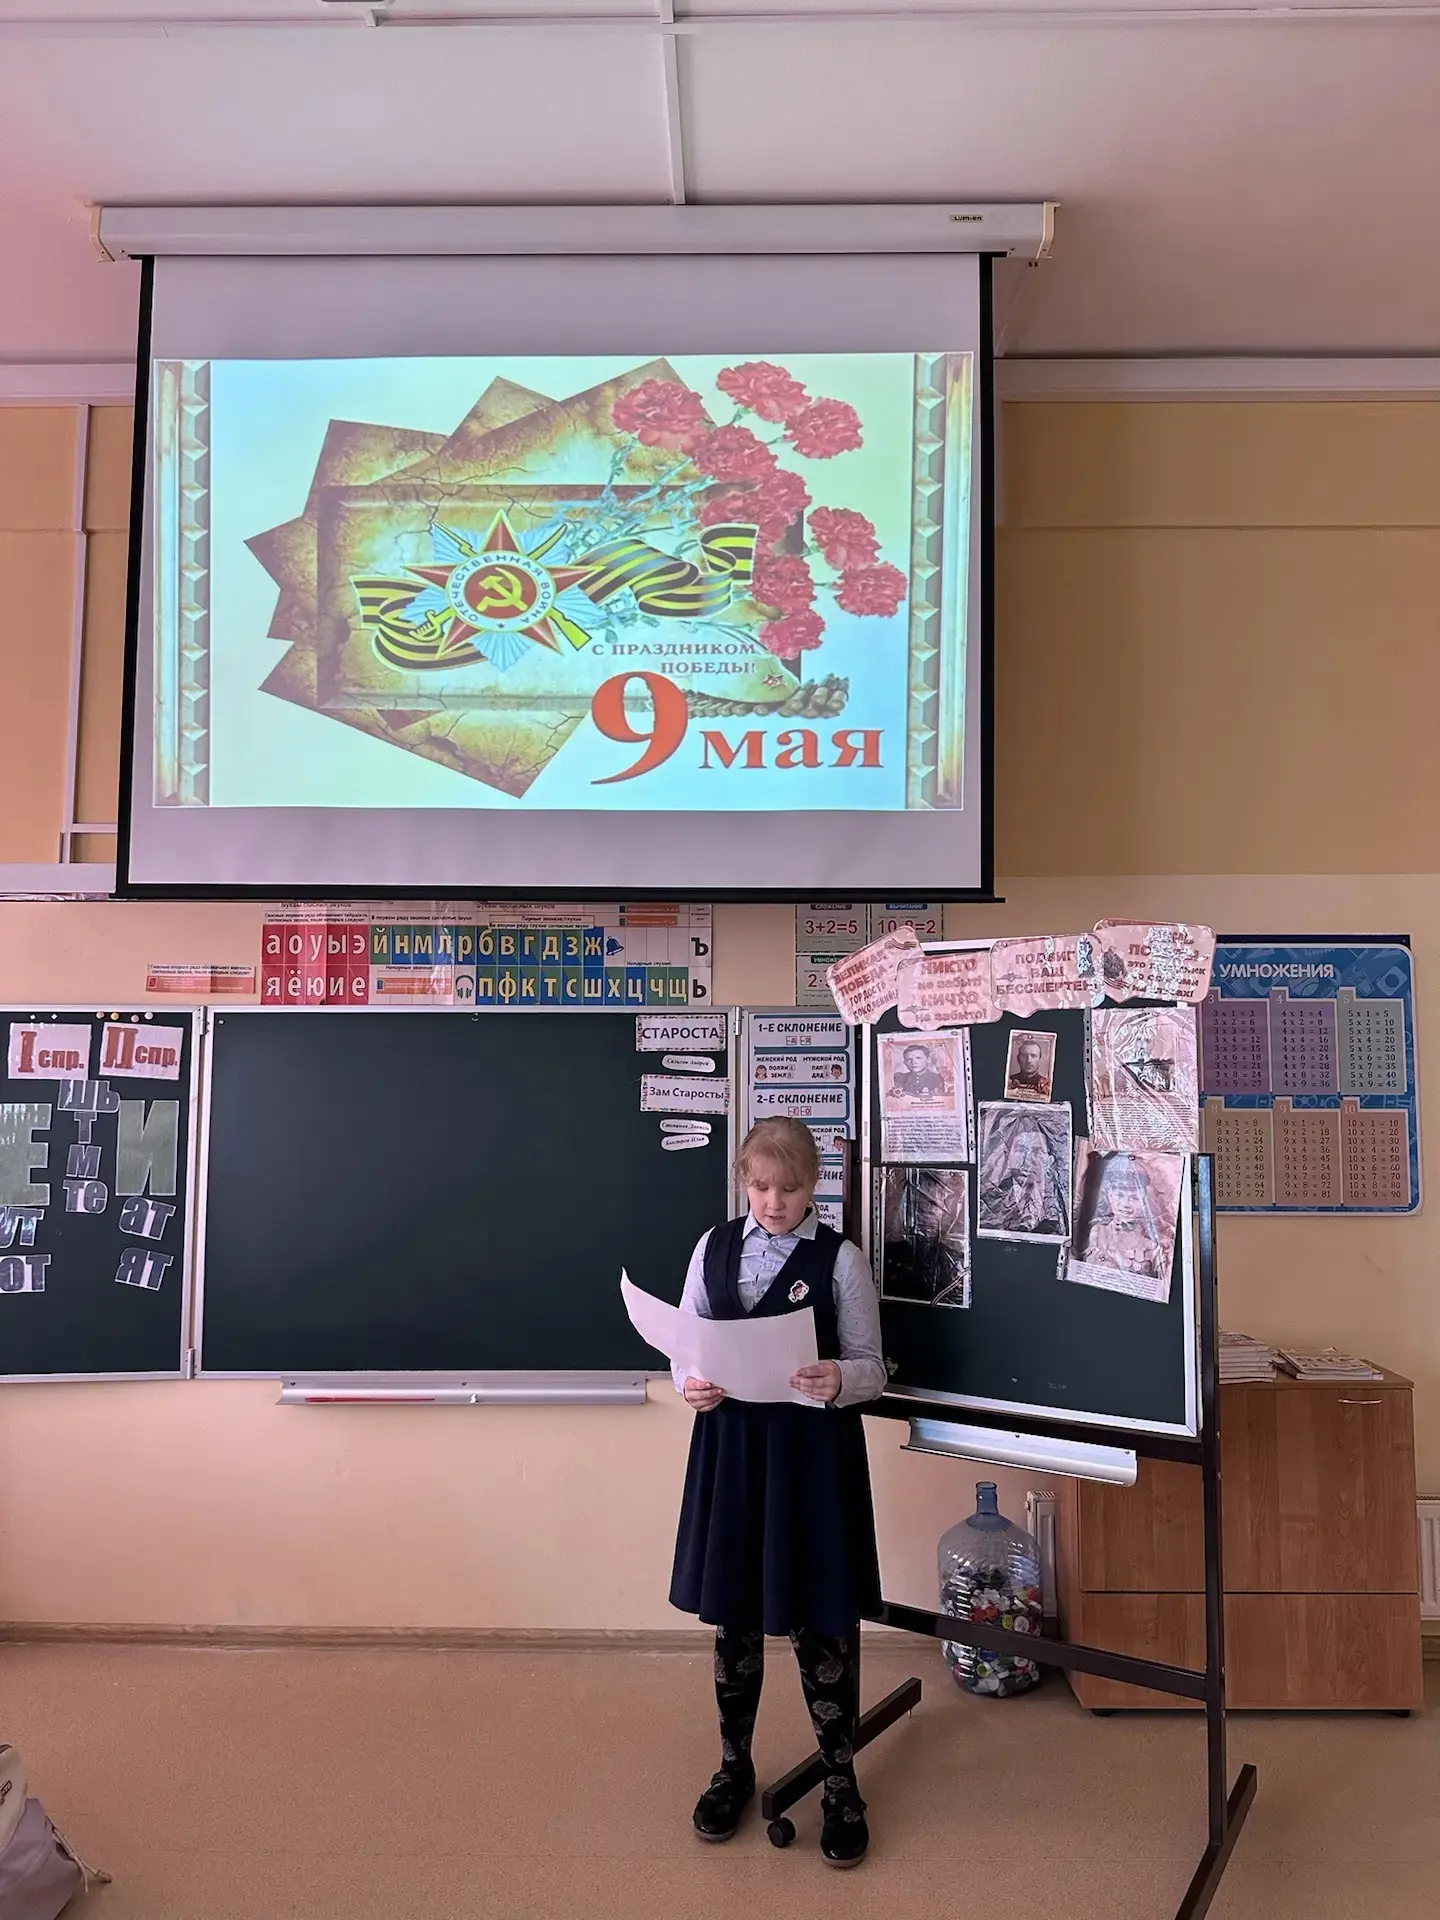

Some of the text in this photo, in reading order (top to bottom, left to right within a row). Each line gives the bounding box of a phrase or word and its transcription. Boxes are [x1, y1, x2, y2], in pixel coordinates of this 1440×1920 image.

[451, 555, 543, 621] ОТЕЧЕСТВЕННАЯ
[592, 643, 756, 656] С ПРАЗДНИКОМ
[661, 662, 755, 674] ПОБЕДЫ!
[591, 671, 885, 785] 9 мая
[267, 935, 280, 954] а
[289, 935, 302, 954] о
[310, 935, 322, 961] у
[328, 935, 346, 954] ы
[353, 935, 365, 954] э
[374, 928, 387, 954] й
[395, 935, 409, 954] н
[415, 935, 432, 954] м
[458, 935, 472, 961] р
[479, 929, 493, 955] б
[501, 936, 515, 955] в
[524, 936, 534, 955] г
[543, 936, 558, 960] д
[566, 936, 578, 955] з
[585, 937, 601, 955] ж
[921, 959, 977, 974] НИКТО
[1030, 967, 1064, 978] ВАШ
[1220, 964, 1334, 977] УМНОЖЕНИЯ
[266, 977, 280, 996] я
[288, 969, 301, 996] ё
[307, 977, 324, 996] ю
[330, 977, 343, 996] и
[352, 977, 365, 996] е
[479, 978, 493, 996] п
[499, 971, 517, 1004] ф
[522, 979, 535, 997] к
[544, 979, 556, 997] т
[566, 979, 577, 997] с
[584, 979, 601, 997] ш
[608, 979, 620, 997] х
[628, 979, 642, 1002] ц
[650, 979, 663, 998] ч
[670, 979, 686, 1002] щ
[642, 1027, 719, 1039] СТАРОСТА
[759, 1023, 842, 1032] 1-Е СКЛОНЕНИЕ
[650, 1087, 724, 1099] Зам Старосты
[757, 1094, 843, 1103] 2-Е СКЛОНЕНИЕ
[1344, 1105, 1356, 1114] 10
[116, 1100, 179, 1196] И
